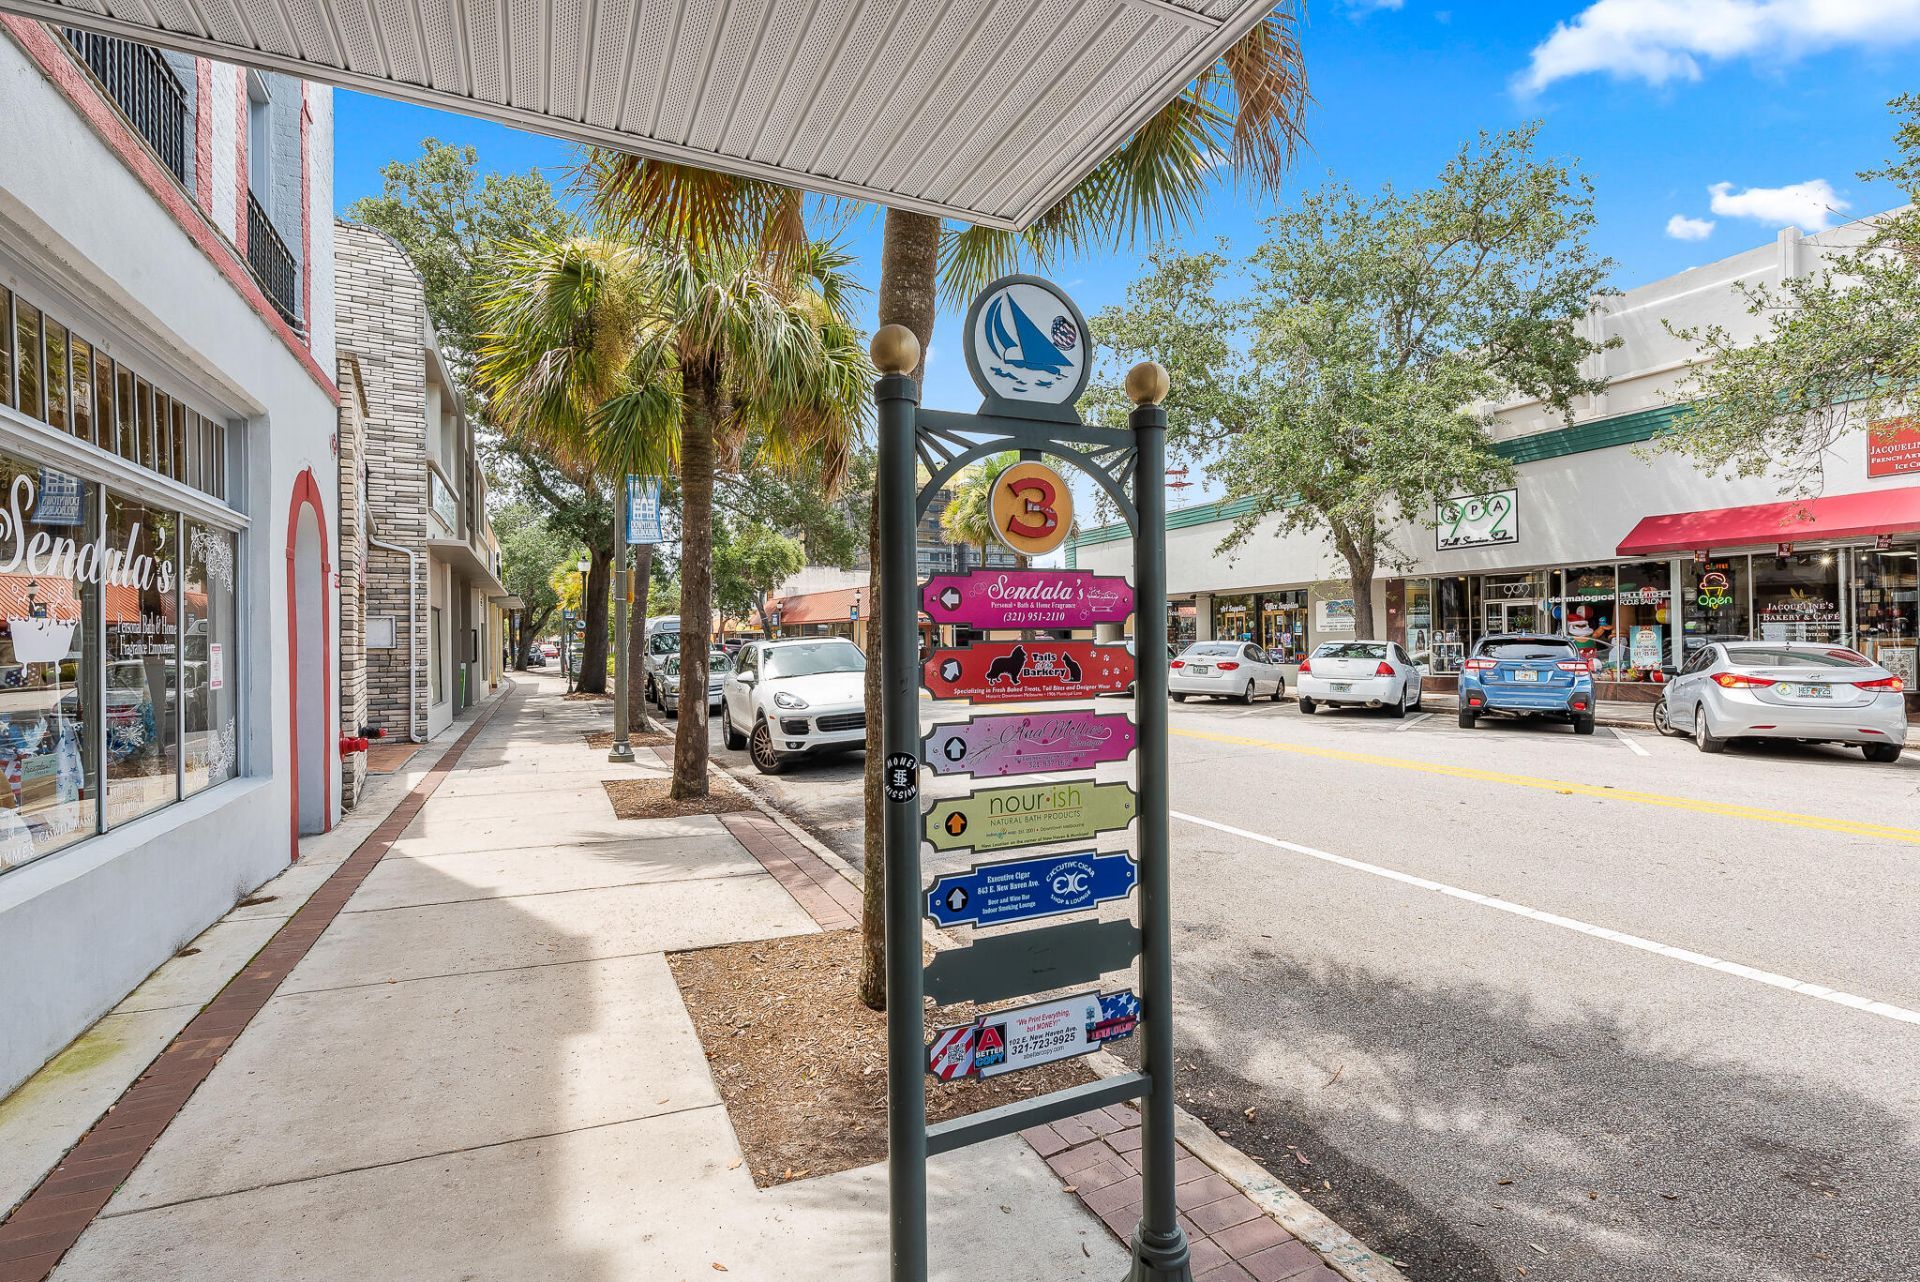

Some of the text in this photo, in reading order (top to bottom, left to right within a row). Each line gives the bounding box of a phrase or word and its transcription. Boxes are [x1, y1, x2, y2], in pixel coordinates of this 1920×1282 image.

[1871, 455, 1902, 464] FRENCH
[1008, 477, 1058, 538] 3
[0, 475, 176, 594] Sendala's
[988, 574, 1084, 600] Sendala's
[1548, 593, 1614, 603] dermalogica
[1698, 595, 1732, 608] Open
[117, 611, 142, 634] Personal
[142, 612, 156, 634] Bath
[1004, 612, 1026, 622] (321)
[1031, 652, 1057, 662] Tails
[1022, 668, 1066, 678] Barkery
[954, 688, 984, 696] Specializing
[887, 756, 918, 770] MONEY
[885, 784, 916, 799] MISSION
[990, 818, 1022, 826] NATURAL
[1044, 810, 1080, 820] PRODUCTS
[987, 872, 1030, 884] Executive Cigar
[996, 884, 1008, 892] New
[1010, 882, 1028, 890] Haven
[1028, 880, 1040, 888] Ave.
[988, 898, 999, 906] Beer
[1000, 896, 1008, 904] and
[998, 903, 1018, 912] Smoking
[1019, 901, 1036, 909] Lounge
[1028, 1014, 1041, 1024] Print
[978, 1027, 1004, 1052] A
[1009, 1037, 1021, 1046] 102
[1030, 1034, 1043, 1042] New
[1045, 1028, 1064, 1038] Haven
[1065, 1026, 1078, 1034] Ave.
[1011, 1032, 1076, 1056] 321-723-9925
[976, 1046, 1004, 1059] BETTER
[976, 1053, 1004, 1067] COPY
